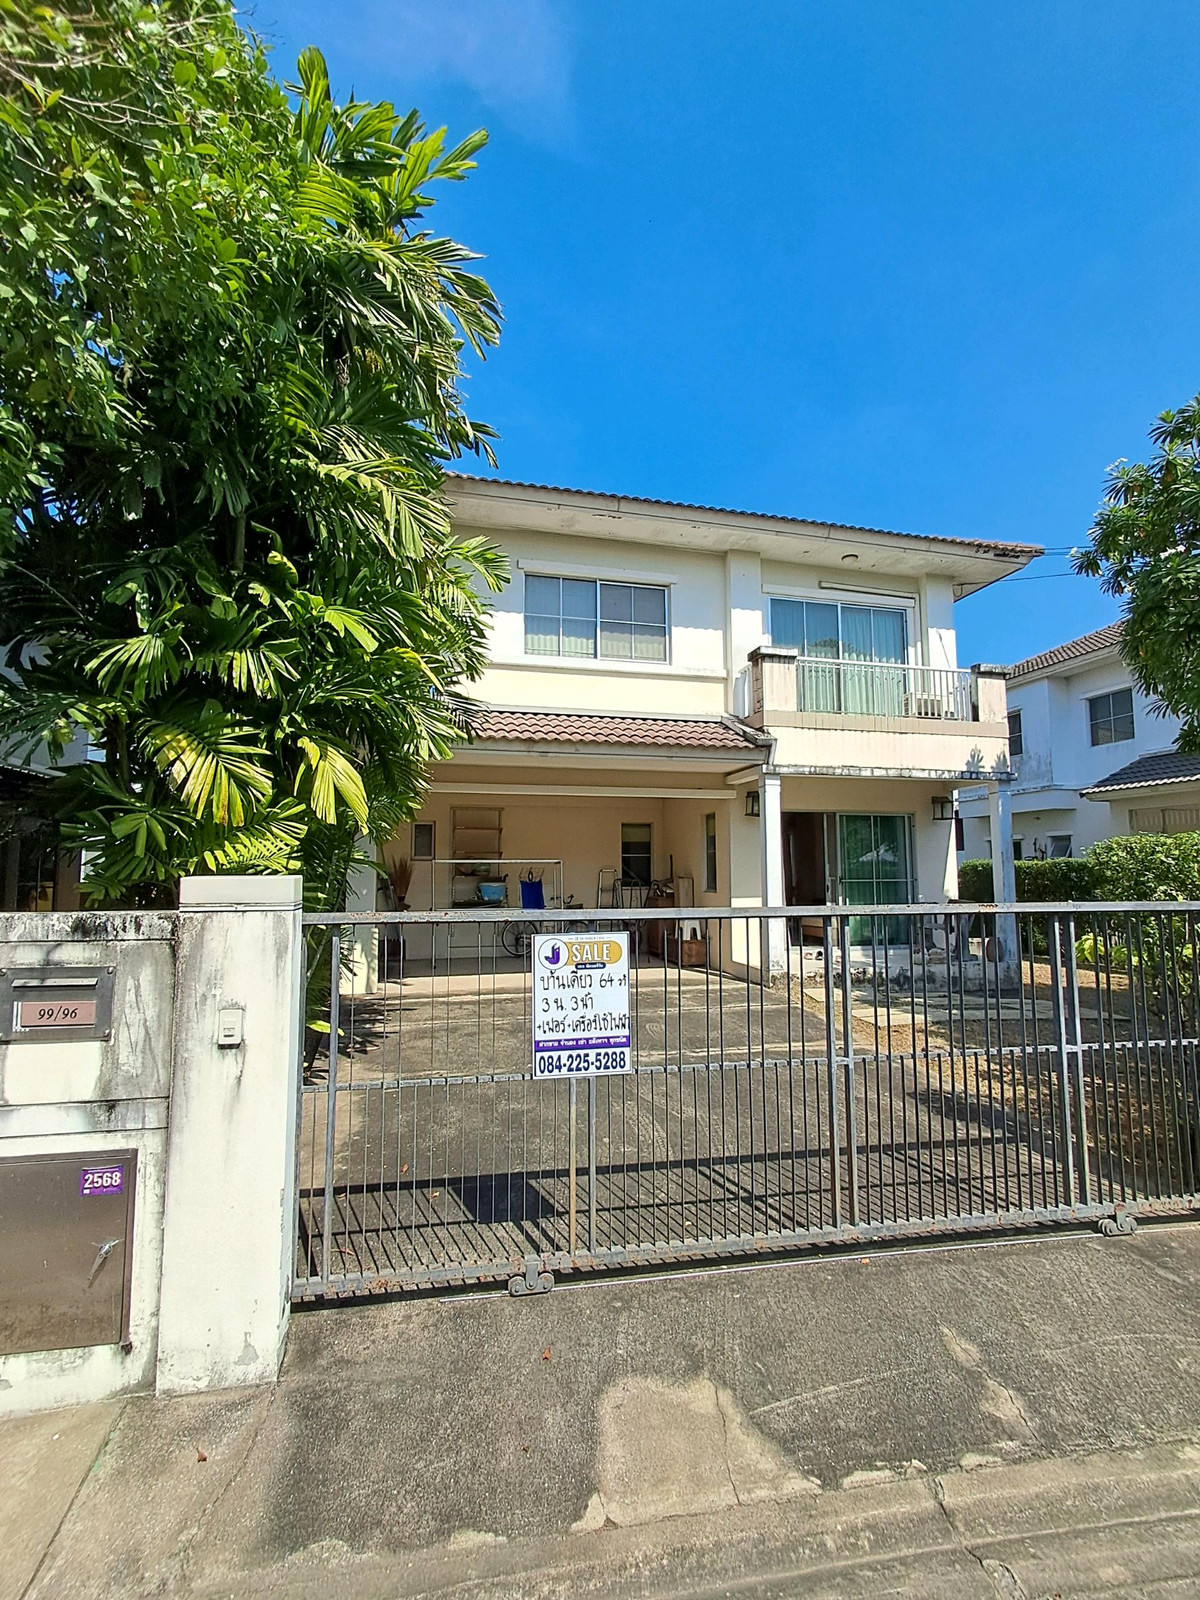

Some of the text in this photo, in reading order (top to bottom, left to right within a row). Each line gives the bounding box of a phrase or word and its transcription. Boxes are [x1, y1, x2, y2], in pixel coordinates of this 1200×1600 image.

[571, 943, 611, 962] SALE
[599, 973, 615, 988] 64
[38, 1005, 78, 1021] 99/96
[541, 997, 550, 1013] 3
[570, 996, 579, 1011] 3
[538, 1050, 627, 1075] 084-225-5288
[83, 1171, 122, 1189] 2568
